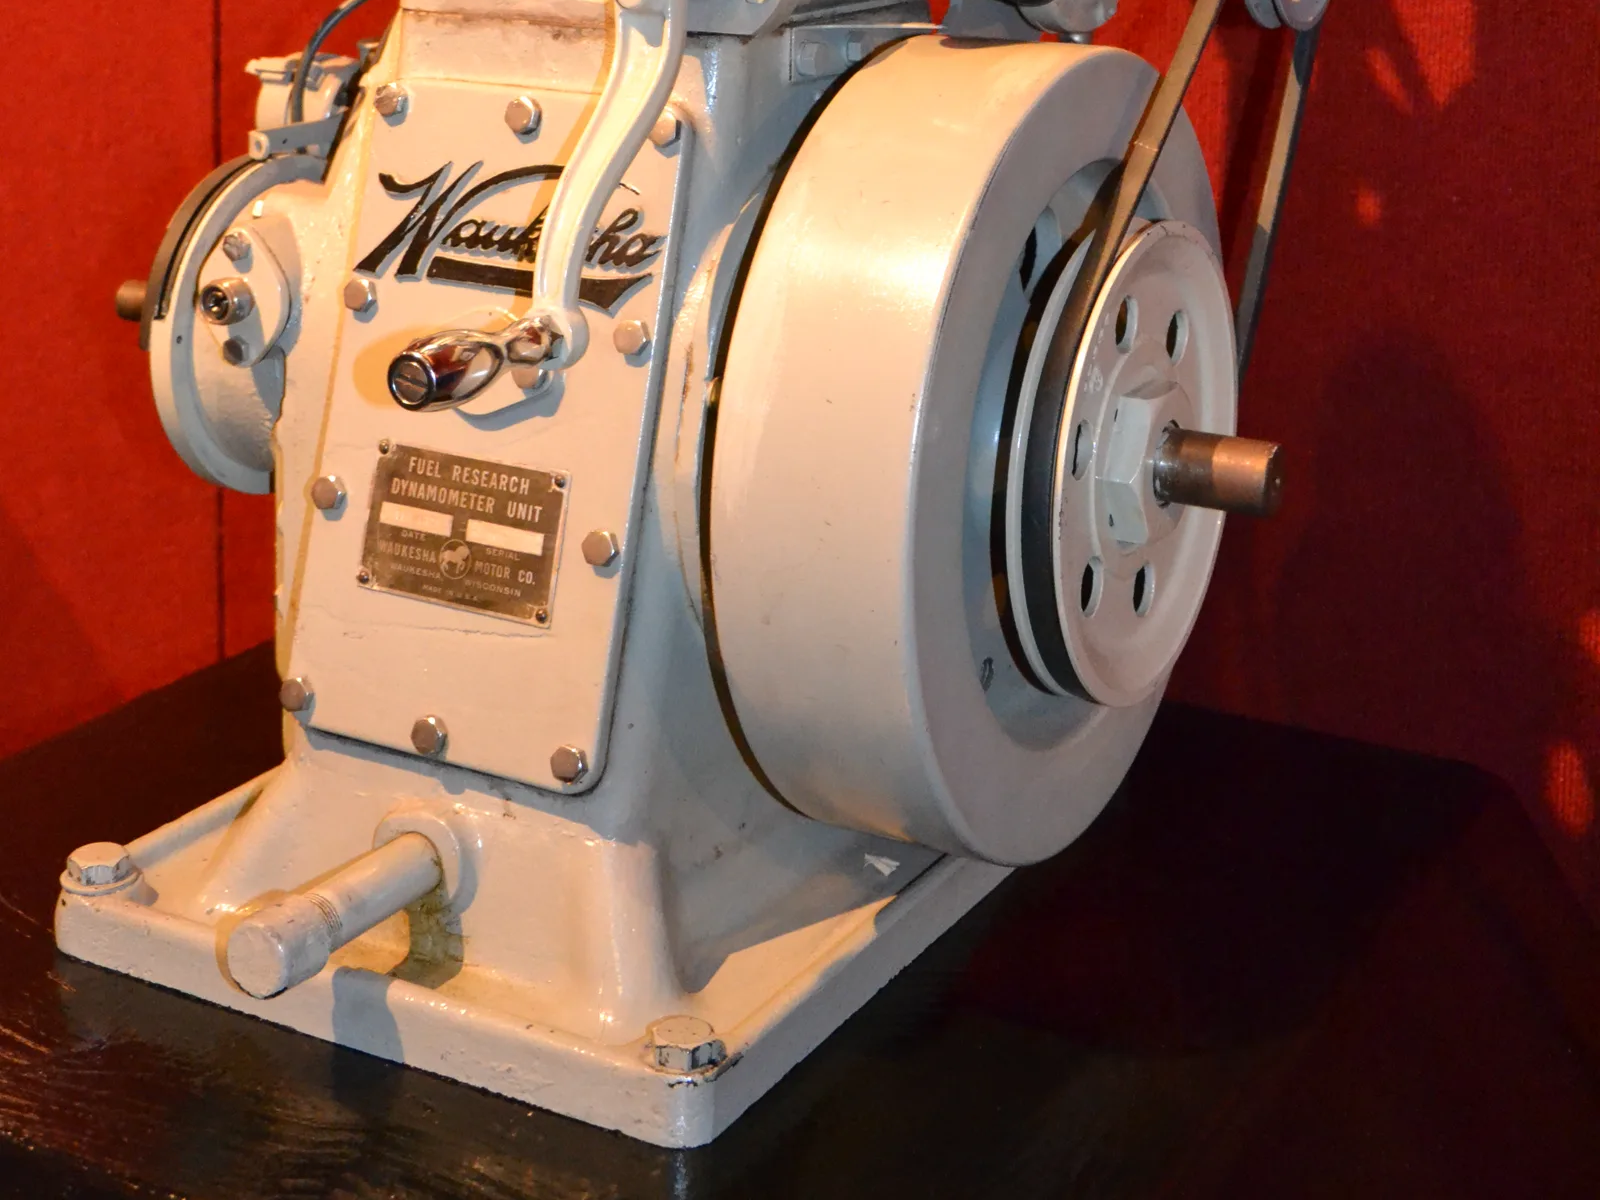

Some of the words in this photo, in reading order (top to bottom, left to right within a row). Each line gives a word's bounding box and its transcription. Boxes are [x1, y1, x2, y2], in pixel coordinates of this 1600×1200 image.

[354, 161, 661, 276] Waukha
[408, 456, 442, 479] FUEL
[452, 465, 530, 495] RESEARCH
[391, 478, 495, 513] DYNAMOMETER
[507, 501, 543, 523] UNIT
[378, 539, 437, 563] WAUKESHA
[474, 560, 511, 579] MOTOR
[518, 569, 536, 585] CO.
[400, 529, 427, 541] DATE
[485, 547, 521, 561] SERIAL
[421, 584, 443, 594] MADE
[465, 578, 522, 597] WISCONSIN
